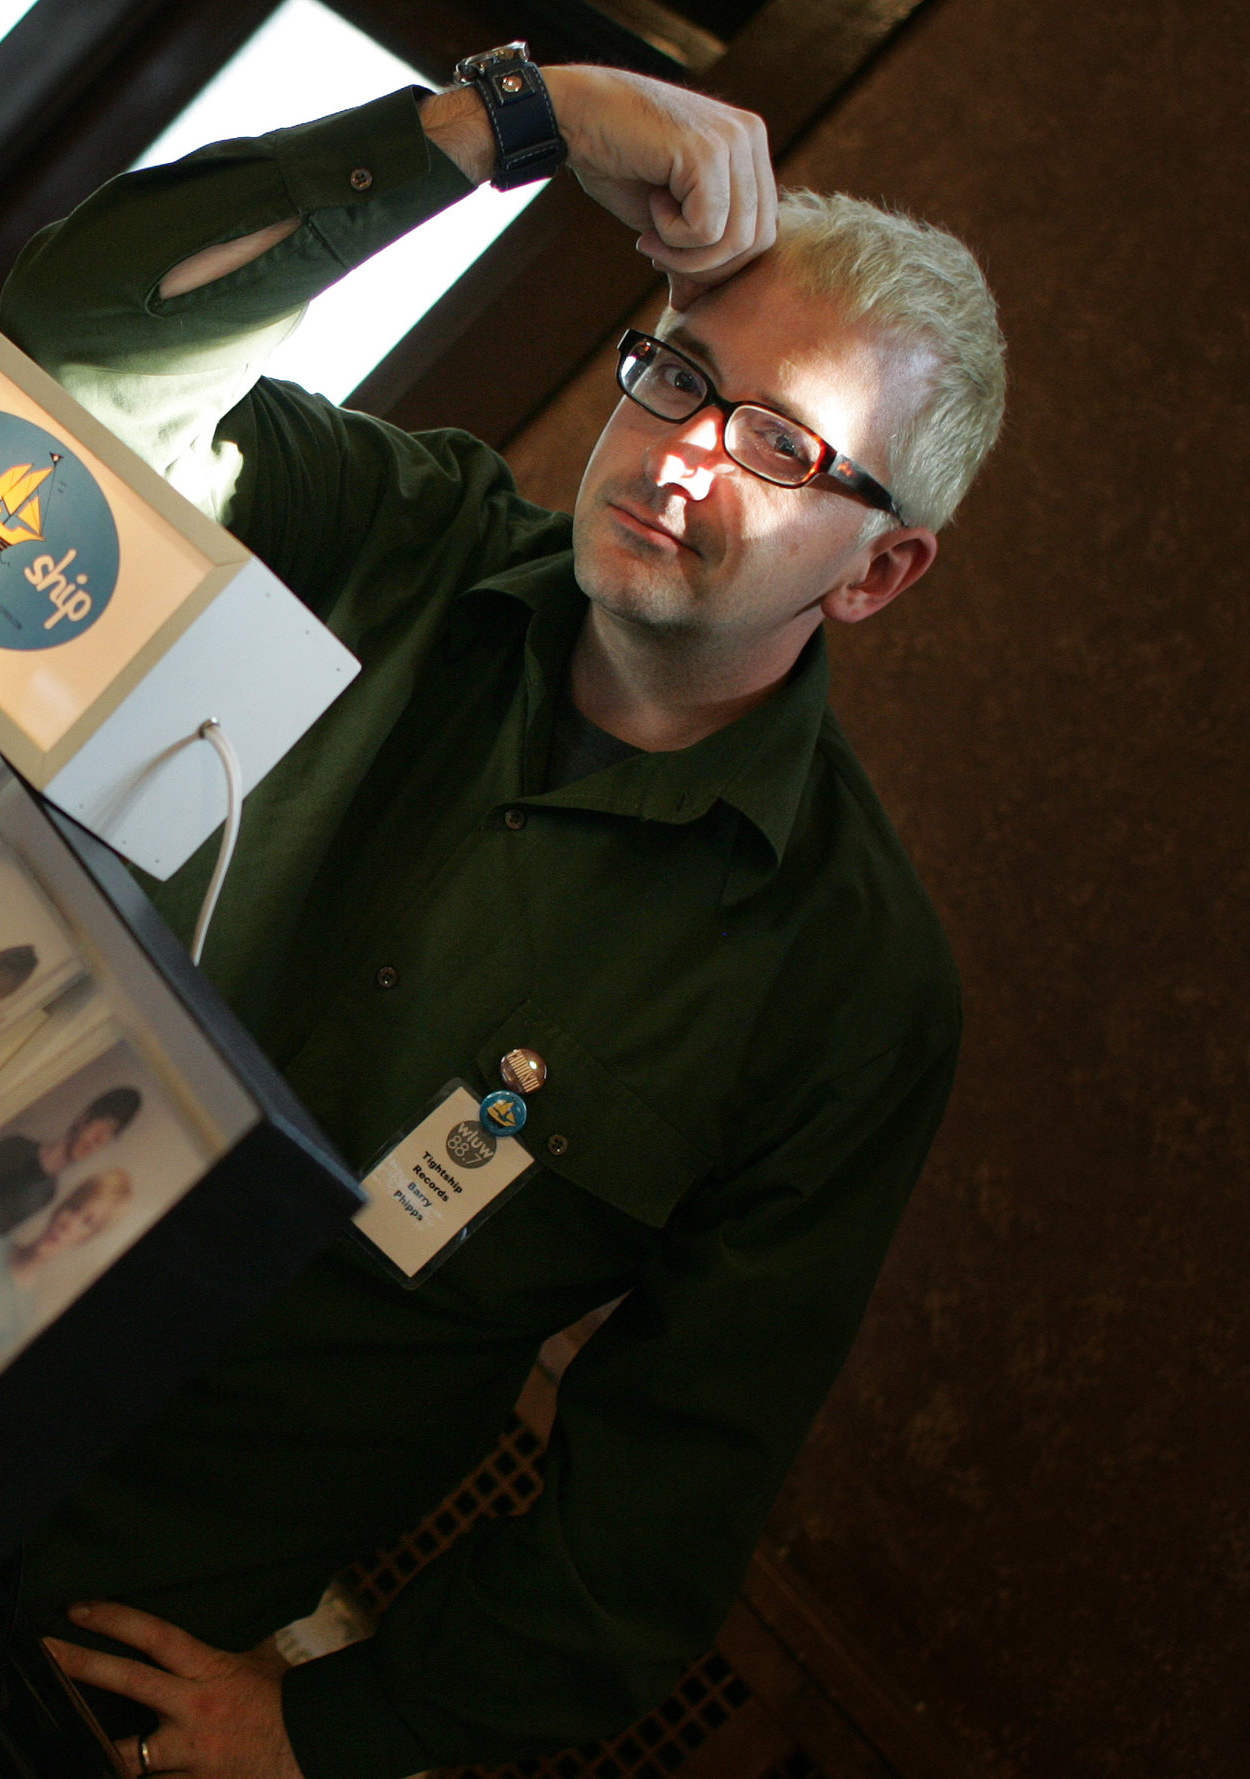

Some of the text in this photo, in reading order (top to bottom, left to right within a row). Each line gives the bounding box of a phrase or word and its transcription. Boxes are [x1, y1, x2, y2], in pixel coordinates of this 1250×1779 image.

[23, 548, 93, 630] ship
[444, 1132, 483, 1170] 88.7
[454, 1119, 496, 1161] wluw
[411, 1163, 452, 1203] Records
[419, 1150, 464, 1195] Tightship
[392, 1188, 425, 1223] Phipps
[406, 1180, 434, 1209] Barry
